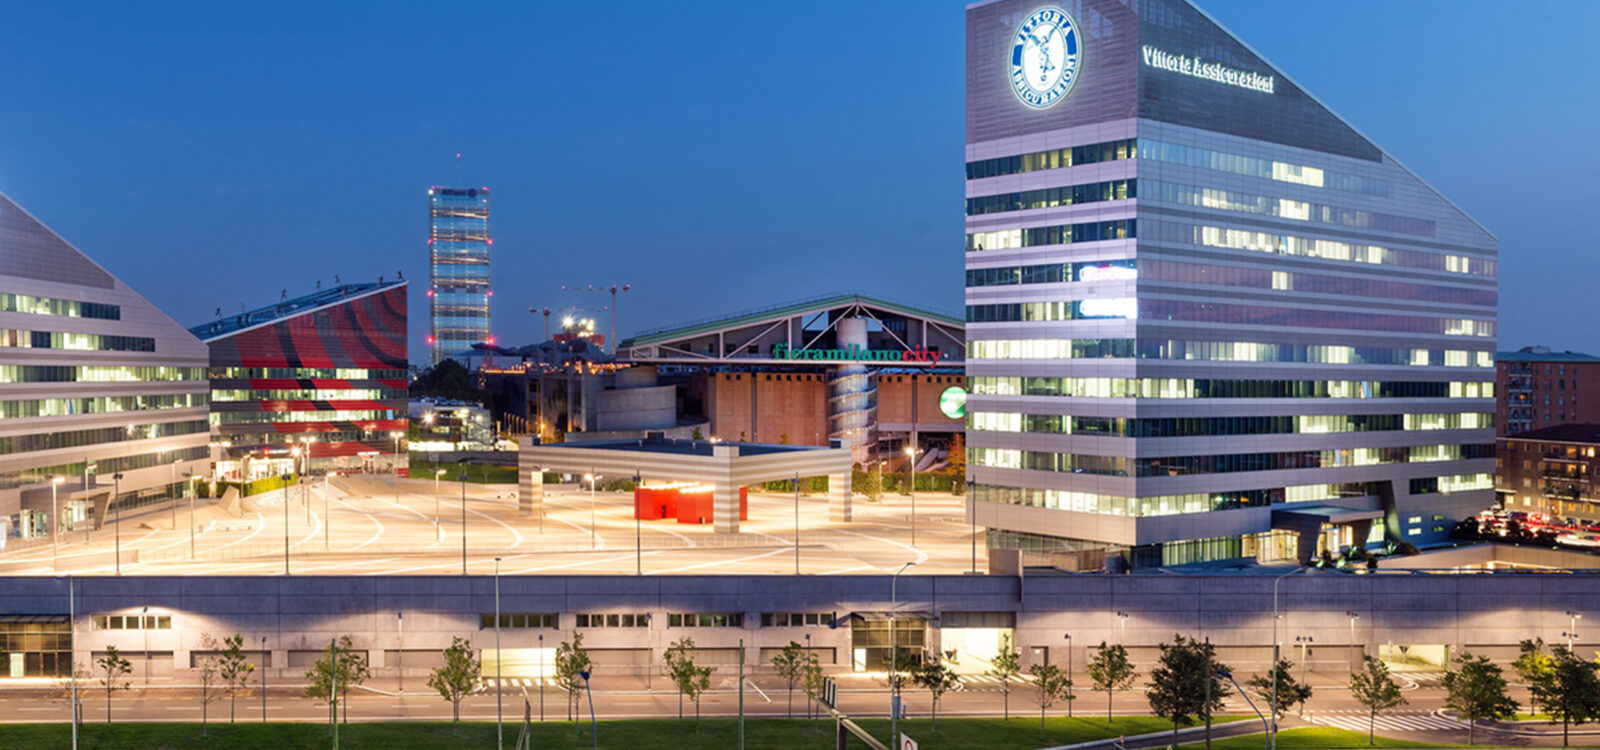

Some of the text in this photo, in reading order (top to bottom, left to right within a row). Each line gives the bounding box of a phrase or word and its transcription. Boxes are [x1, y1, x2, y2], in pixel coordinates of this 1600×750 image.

[1015, 10, 1072, 45] VITTORIA
[1013, 54, 1077, 104] ASSICURAZIONI
[1143, 45, 1274, 93] Vittoria Assicurazioni
[773, 342, 942, 368] fieramilanocity
